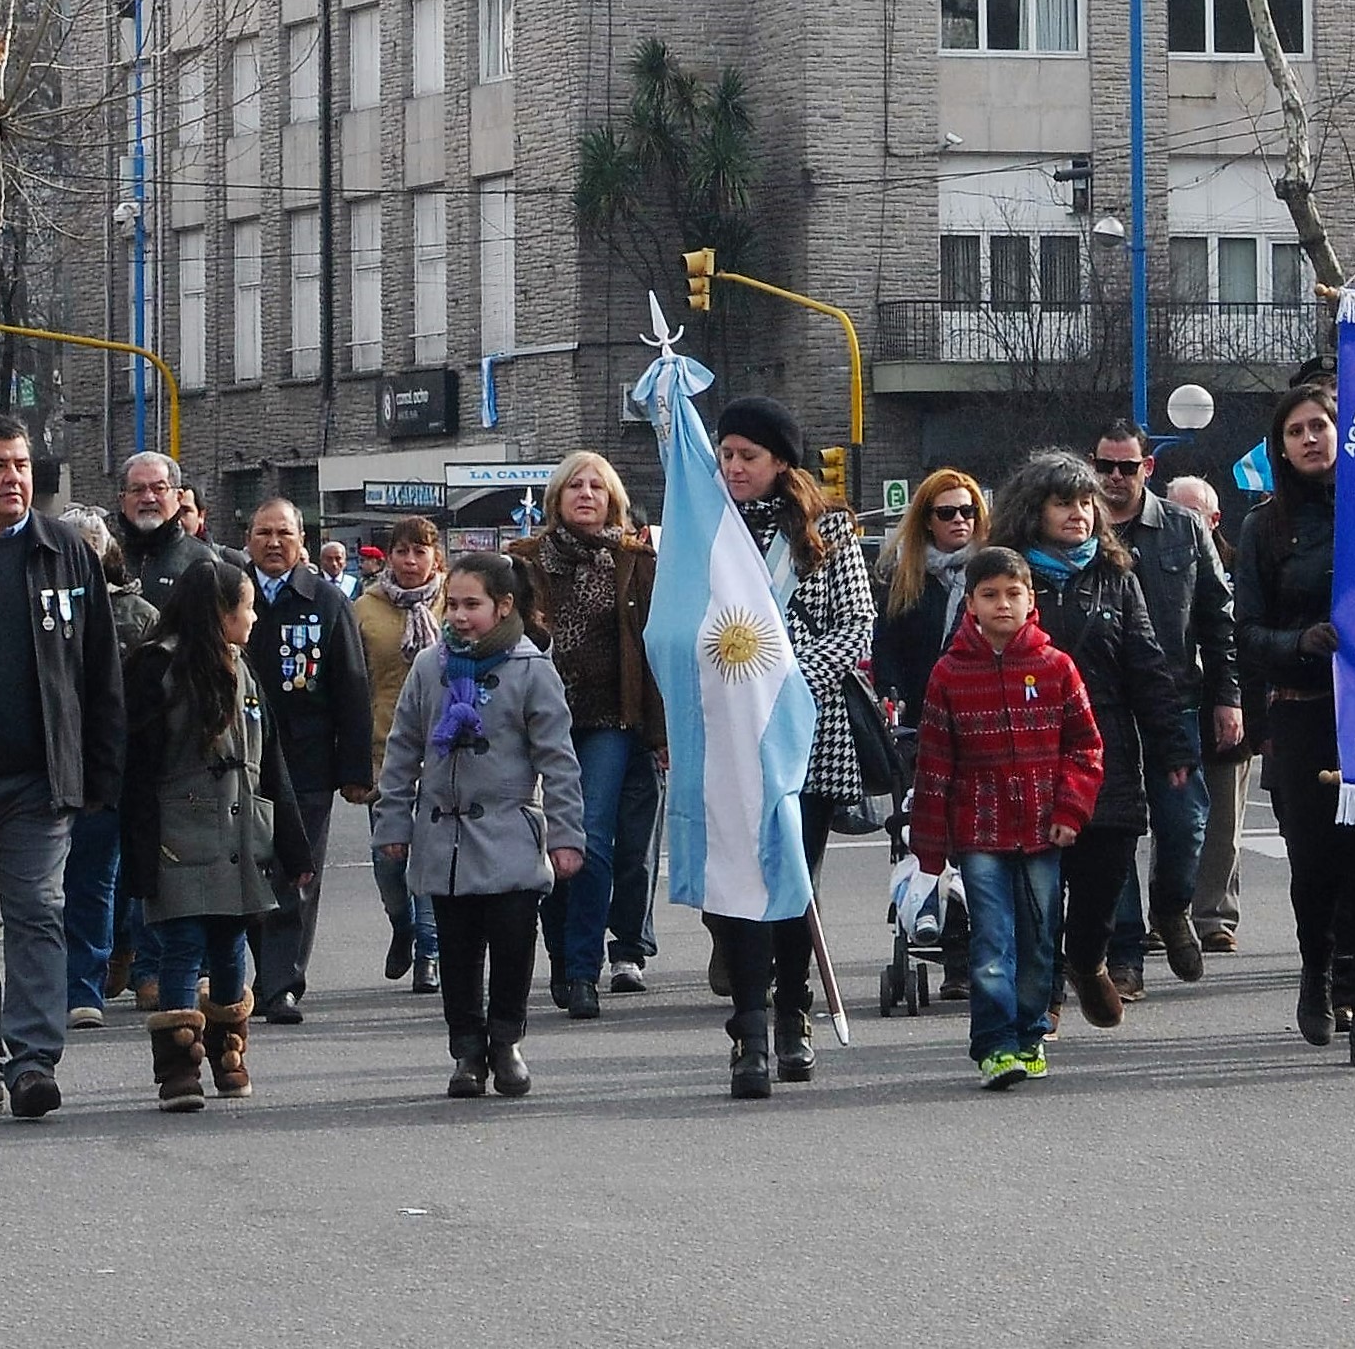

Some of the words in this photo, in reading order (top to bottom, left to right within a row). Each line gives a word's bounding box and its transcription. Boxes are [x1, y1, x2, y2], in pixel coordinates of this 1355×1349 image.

[384, 394, 391, 420] 8
[470, 470, 492, 480] LA
[496, 470, 555, 480] CAPIT
